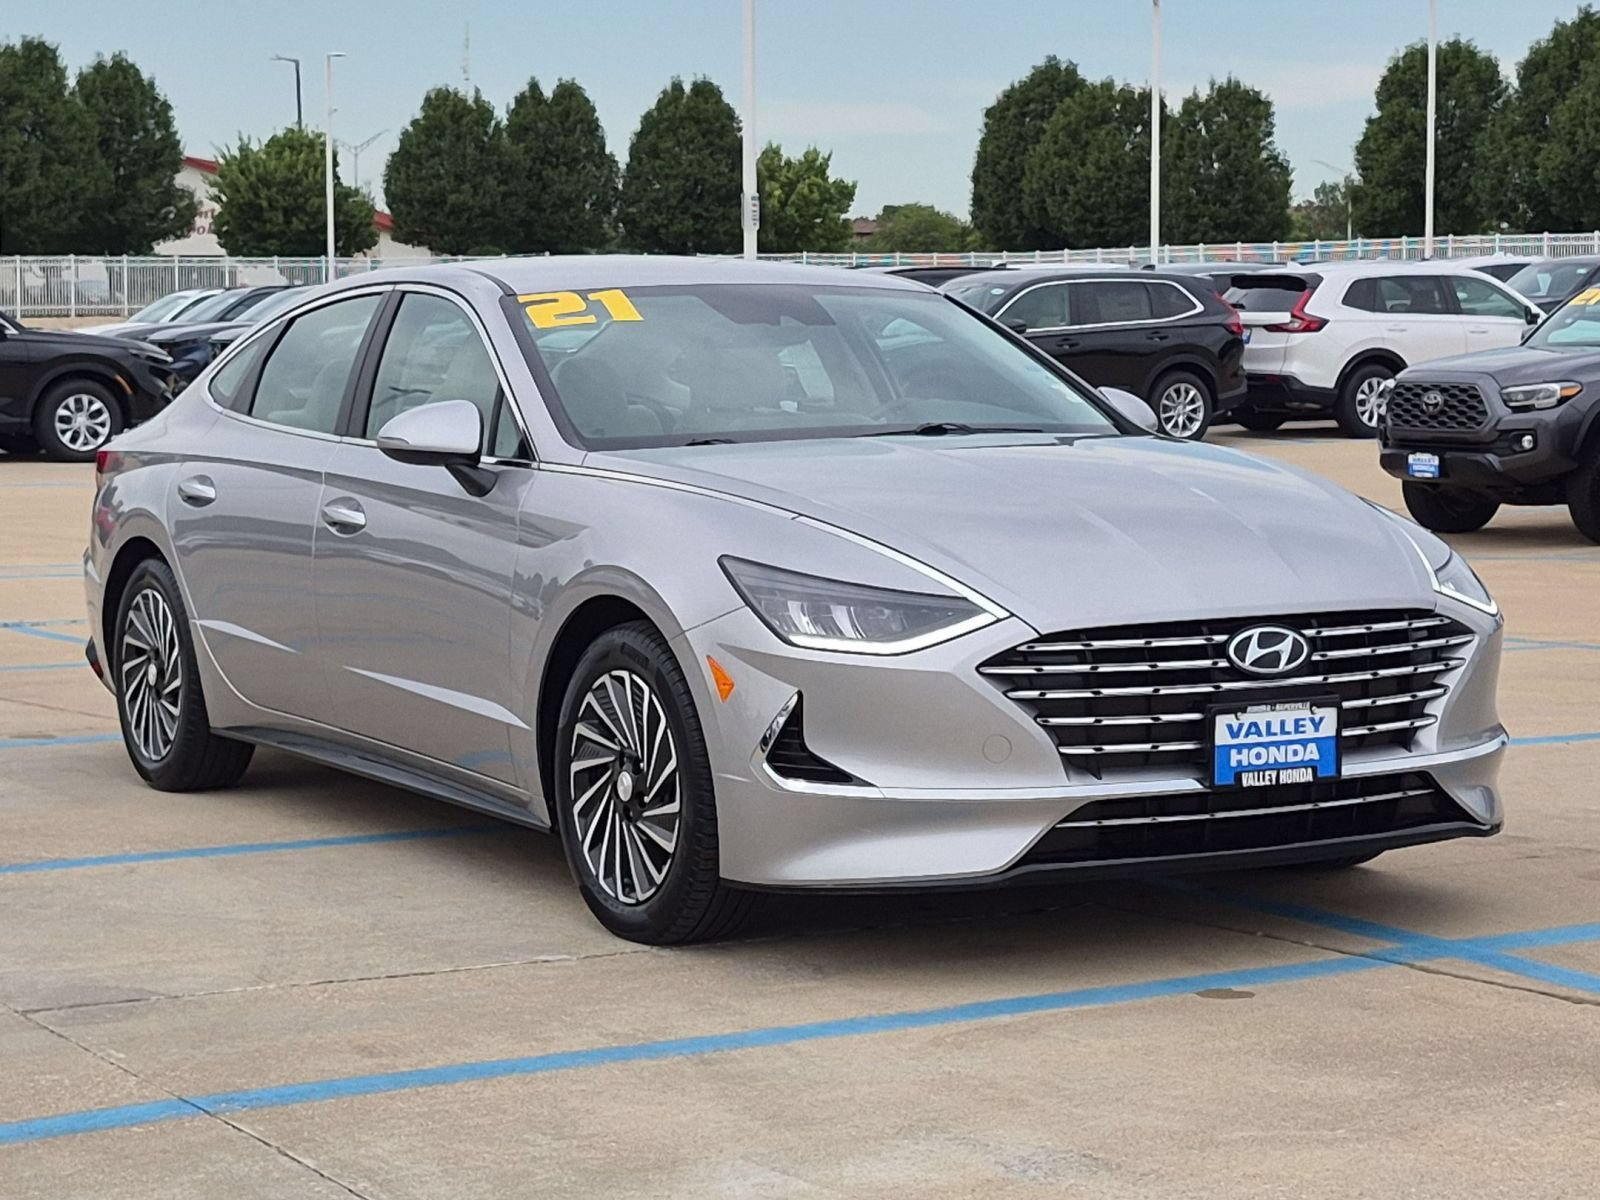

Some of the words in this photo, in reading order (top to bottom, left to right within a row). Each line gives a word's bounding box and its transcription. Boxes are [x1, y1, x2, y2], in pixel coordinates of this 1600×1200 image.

[517, 288, 645, 329] 21
[1225, 716, 1326, 739] VALLEY
[1230, 742, 1320, 768] HONDA
[1241, 769, 1278, 788] VALLEY
[1279, 767, 1313, 785] HONDA
